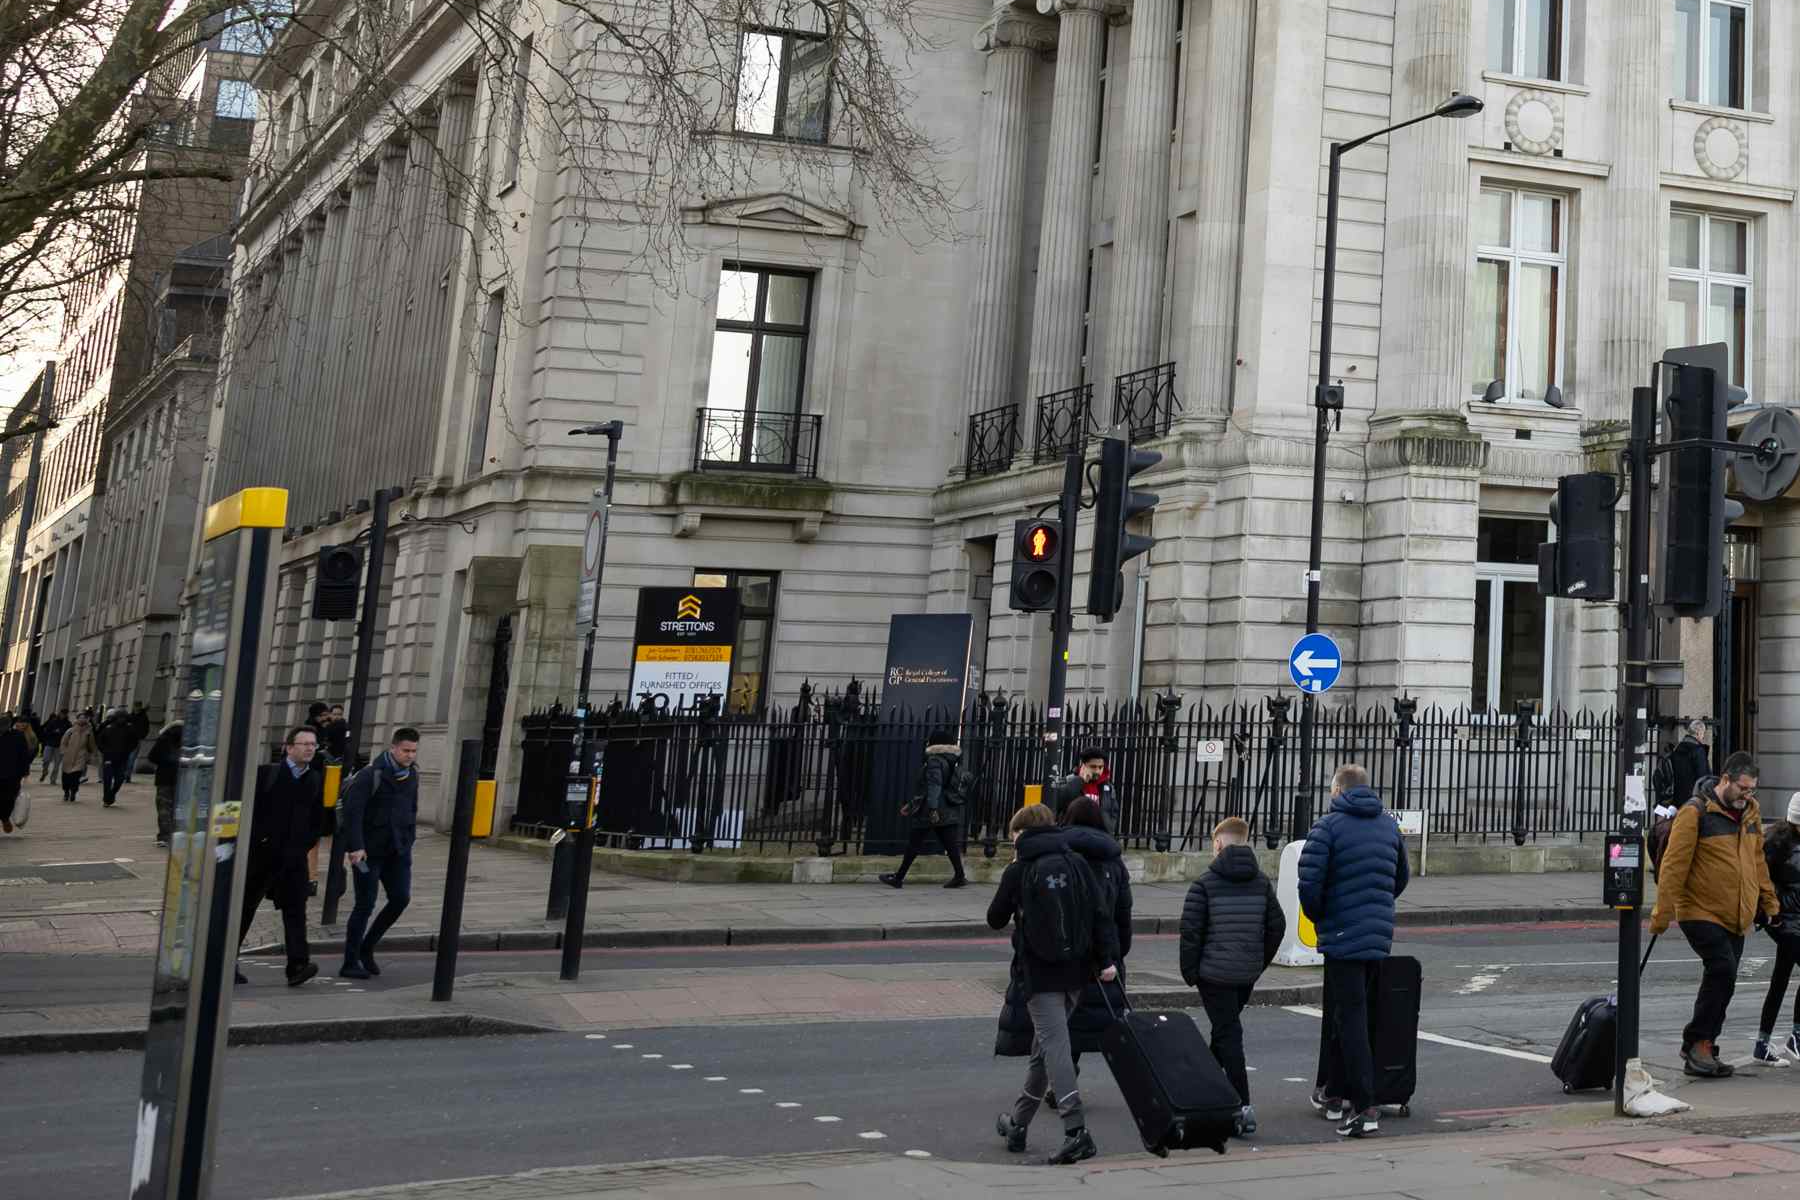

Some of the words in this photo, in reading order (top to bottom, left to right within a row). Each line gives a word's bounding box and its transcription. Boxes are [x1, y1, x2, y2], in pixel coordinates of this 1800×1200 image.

[660, 621, 715, 632] STRETTONS
[665, 672, 693, 680] FITTED
[640, 681, 686, 690] FURNISHED
[688, 681, 722, 690] OFFICES
